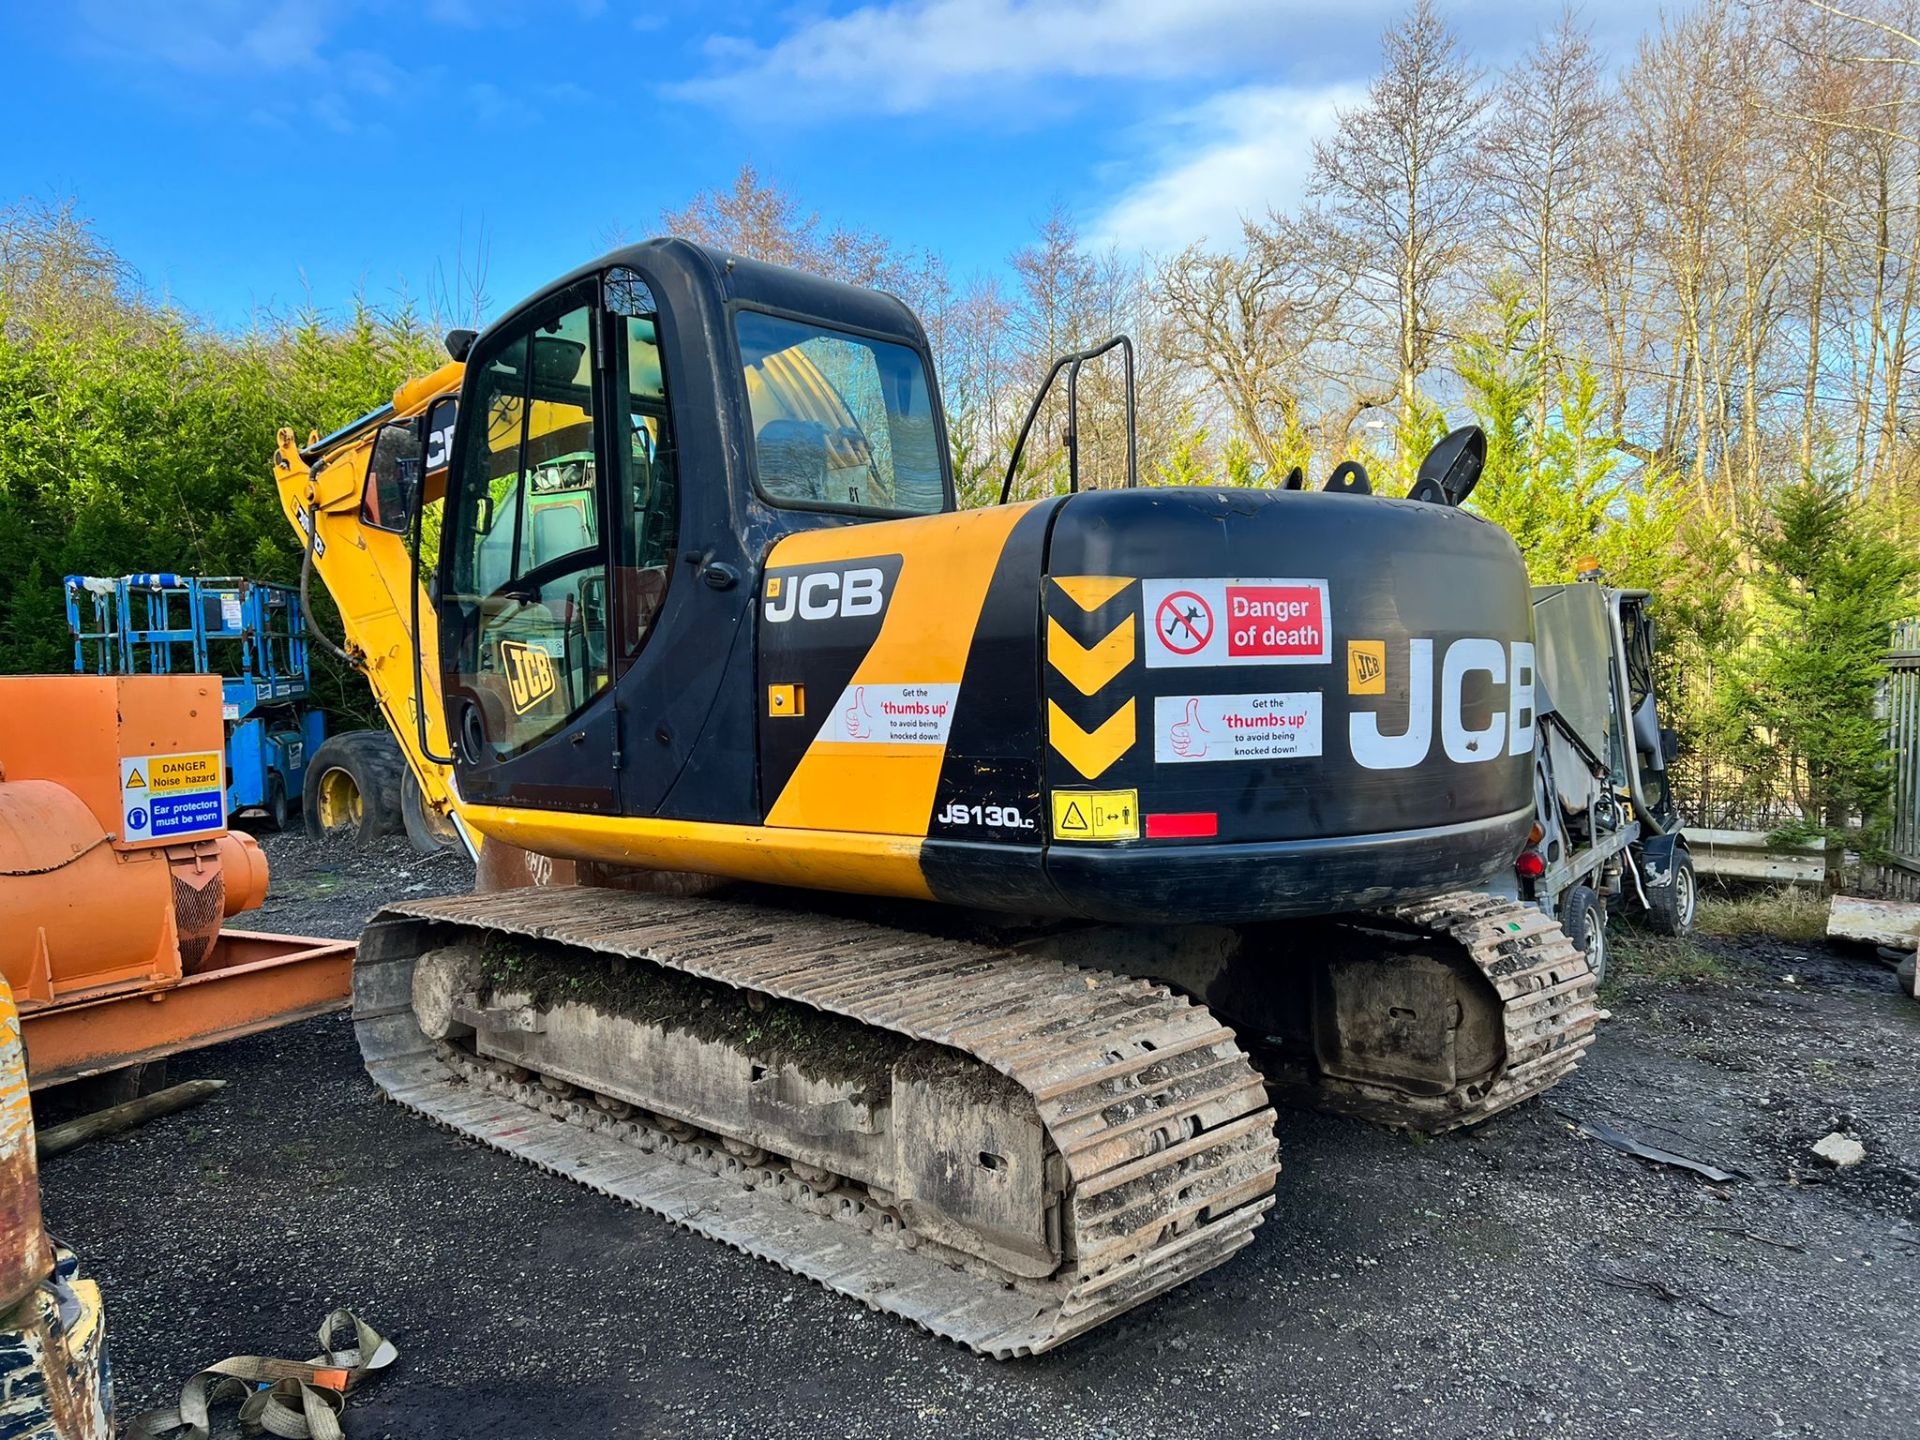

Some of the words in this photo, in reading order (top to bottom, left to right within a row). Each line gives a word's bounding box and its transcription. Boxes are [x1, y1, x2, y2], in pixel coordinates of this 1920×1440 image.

[765, 568, 884, 623] JCB
[1233, 597, 1310, 622] Danger
[1234, 625, 1257, 646] of
[1262, 625, 1319, 646] death
[1358, 654, 1380, 680] JCB
[509, 648, 552, 706] JCB
[902, 688, 915, 697] Get
[916, 687, 928, 697] the
[1252, 699, 1268, 708] Get
[1269, 698, 1284, 708] the
[1349, 638, 1535, 769] JCB
[890, 720, 897, 728] to
[899, 719, 917, 728] avoid
[919, 719, 938, 729] being
[890, 732, 917, 740] knocked
[919, 732, 940, 740] down!
[1235, 734, 1244, 742] to
[1246, 732, 1270, 742] avoid
[1272, 731, 1295, 742] being
[1234, 745, 1270, 756] knocked
[1271, 745, 1298, 754] down!
[162, 761, 206, 773] DANGER
[153, 777, 180, 787] Noise
[185, 772, 216, 784] hazard
[154, 805, 170, 815] Ear
[173, 800, 218, 815] protectors
[156, 816, 179, 827] must
[181, 815, 193, 824] be
[195, 812, 217, 822] worn
